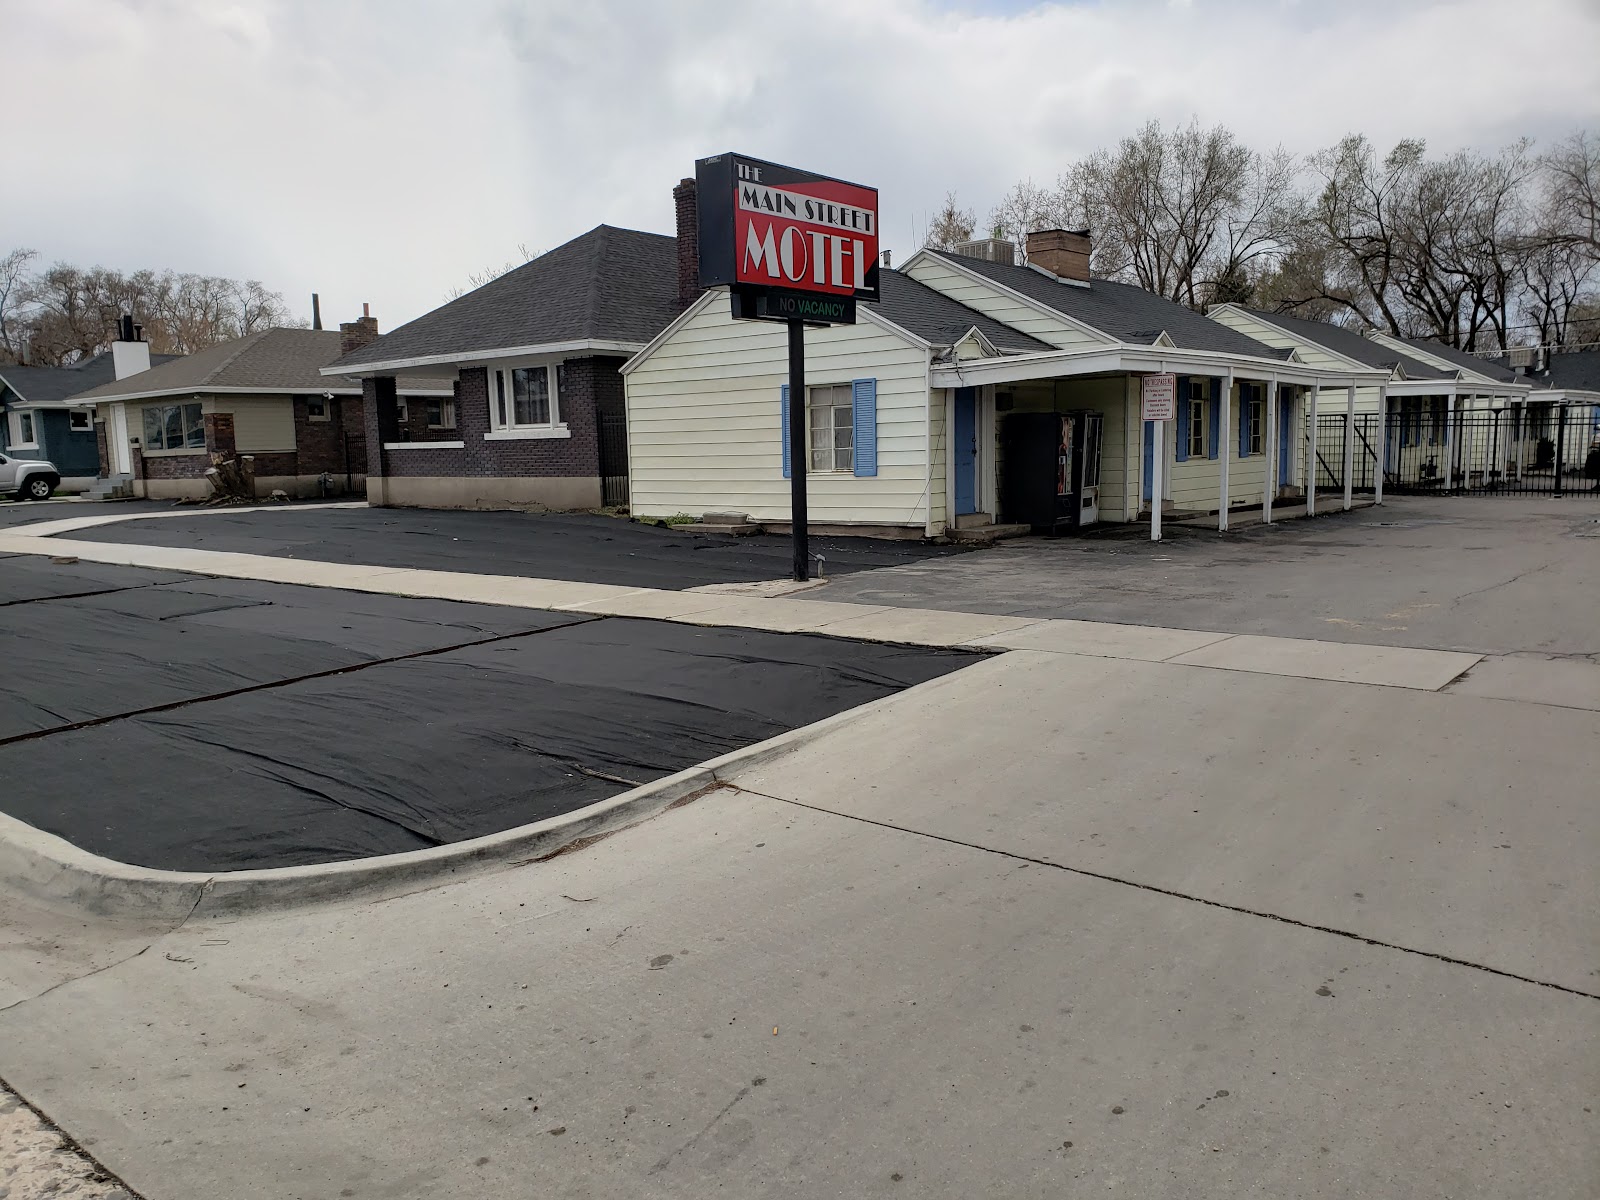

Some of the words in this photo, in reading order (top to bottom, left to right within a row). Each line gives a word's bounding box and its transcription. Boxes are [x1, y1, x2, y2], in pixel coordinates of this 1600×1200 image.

[736, 163, 762, 183] THE
[741, 186, 797, 217] MAIN
[804, 199, 873, 232] STREET
[743, 218, 875, 291] MOTEL
[779, 297, 796, 312] NO
[798, 299, 845, 317] VACANCY
